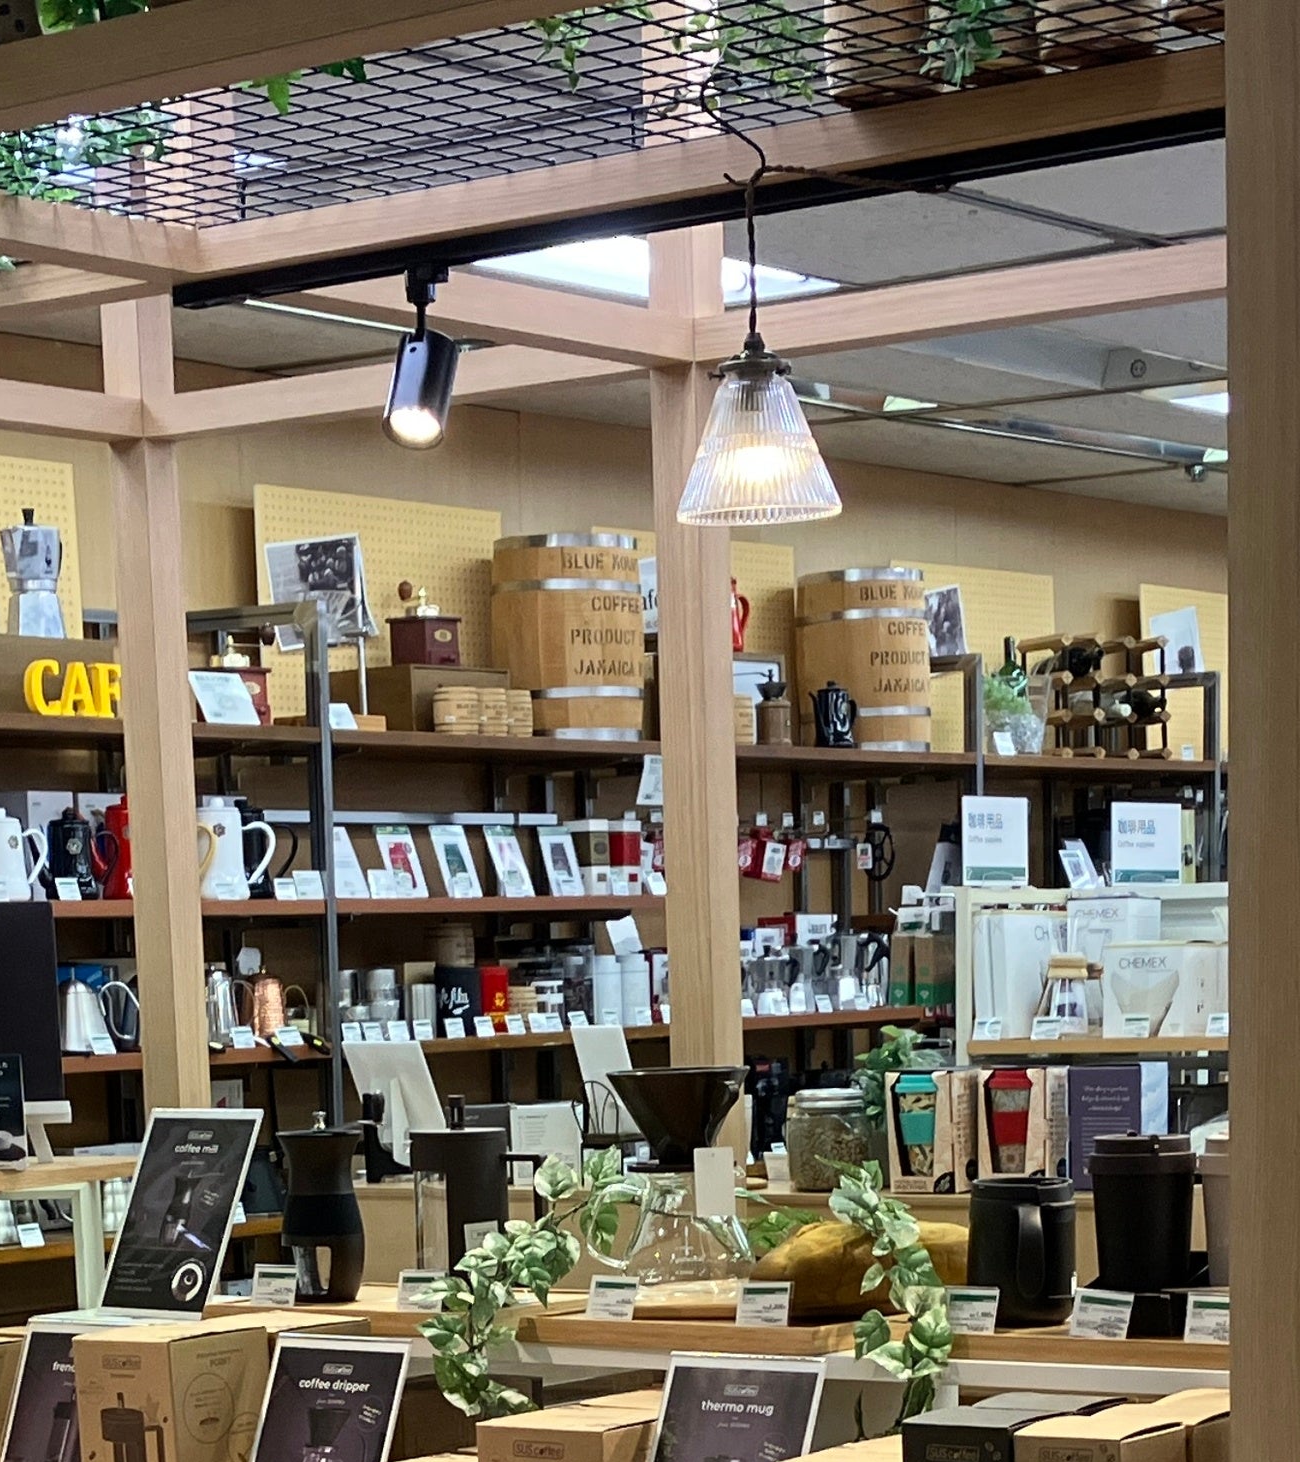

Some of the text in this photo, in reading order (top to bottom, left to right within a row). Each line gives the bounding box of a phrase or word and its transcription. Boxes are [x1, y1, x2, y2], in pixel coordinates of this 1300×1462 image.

[562, 552, 604, 570] BLUE
[860, 584, 897, 601] BLUE
[591, 595, 640, 614] COFFEE
[571, 628, 636, 646] PRODUCT
[870, 650, 926, 667] PRODUCT
[1117, 818, 1156, 835] 珈琲用品
[1074, 908, 1120, 921] CHEMEX
[1119, 956, 1167, 970] CHEMEX
[299, 1378, 370, 1393] coffee dripper
[701, 1399, 775, 1417] thermo mug
